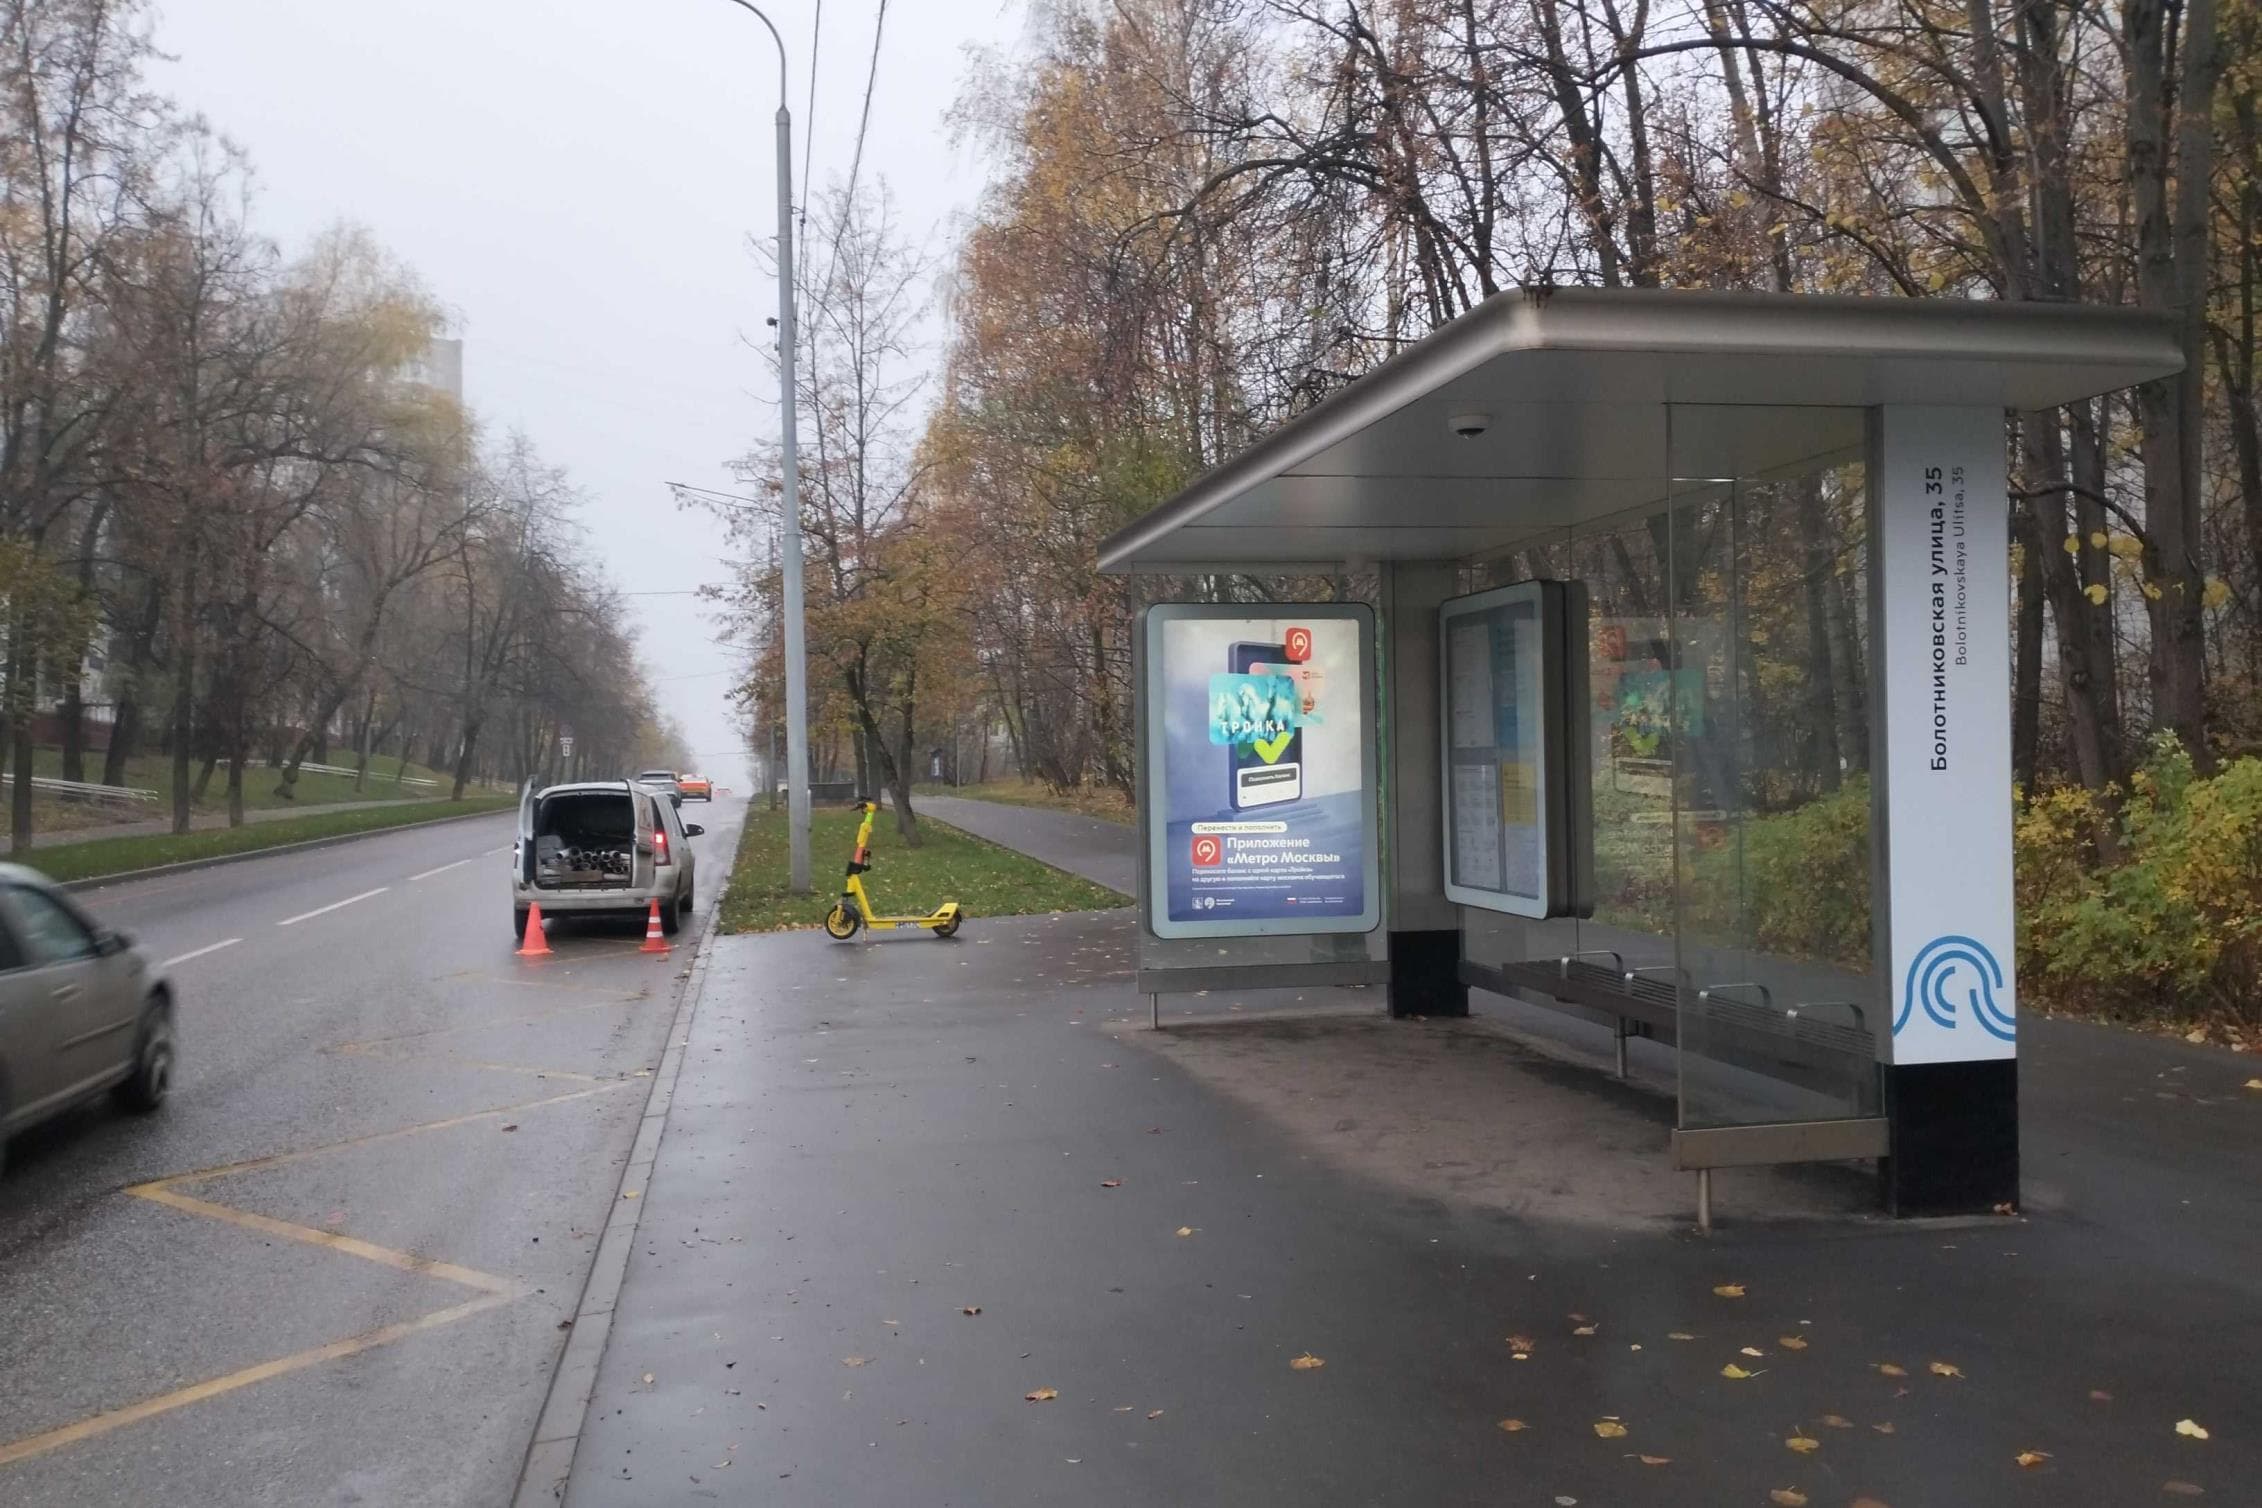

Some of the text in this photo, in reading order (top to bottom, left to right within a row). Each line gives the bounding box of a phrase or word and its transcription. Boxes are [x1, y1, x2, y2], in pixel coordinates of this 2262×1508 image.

[1926, 467, 1947, 771] Болотниковская улица, 35
[1952, 466, 1967, 666] Bolotnikovskaya Ulitsa, 35
[1227, 837, 1310, 851] Приложение
[1227, 851, 1341, 866] «Метро Москвы»
